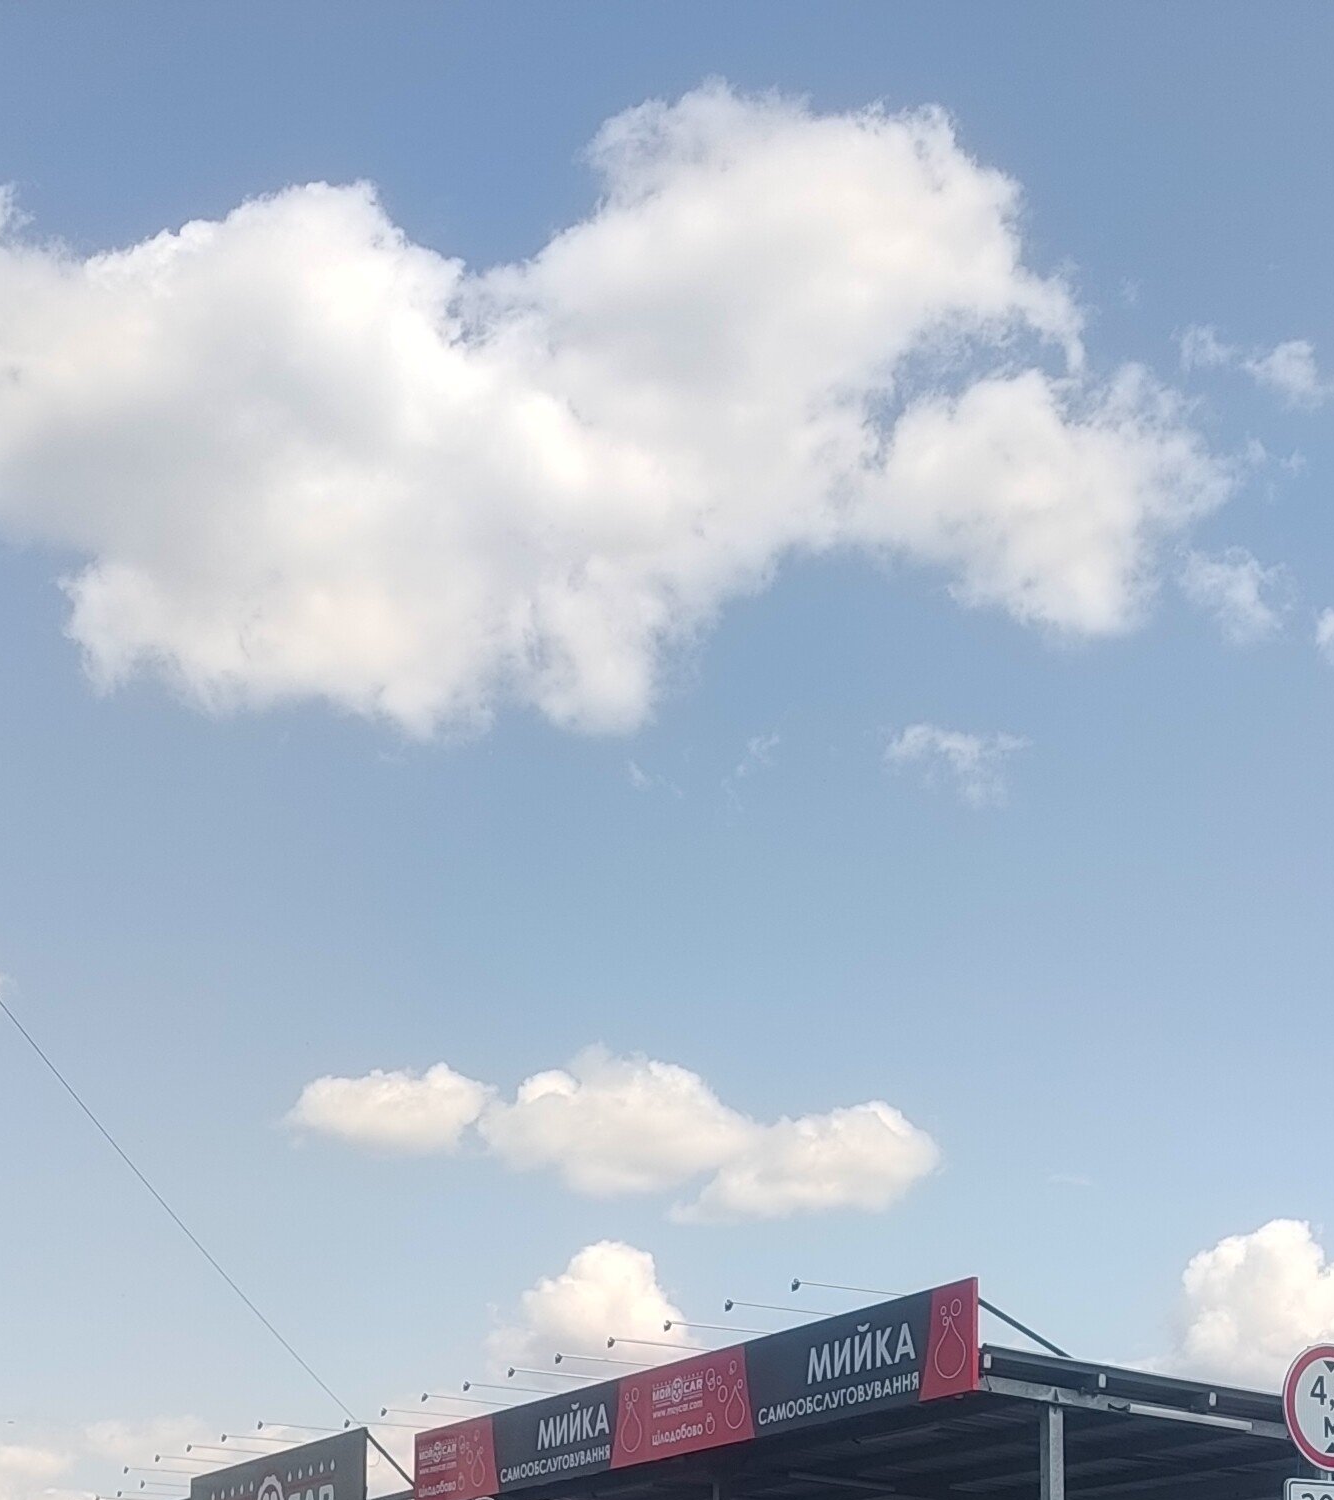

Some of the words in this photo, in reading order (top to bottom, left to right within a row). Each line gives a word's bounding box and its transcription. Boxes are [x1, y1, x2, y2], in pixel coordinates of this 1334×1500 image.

[807, 1322, 916, 1385] МИЙКА
[683, 1379, 703, 1393] CAR
[758, 1371, 920, 1425] САМООБСЛУГОВУВАННЯ
[537, 1402, 610, 1450] МИЙКА
[500, 1444, 611, 1483] САМООБСЛУГОВУВАННЯ
